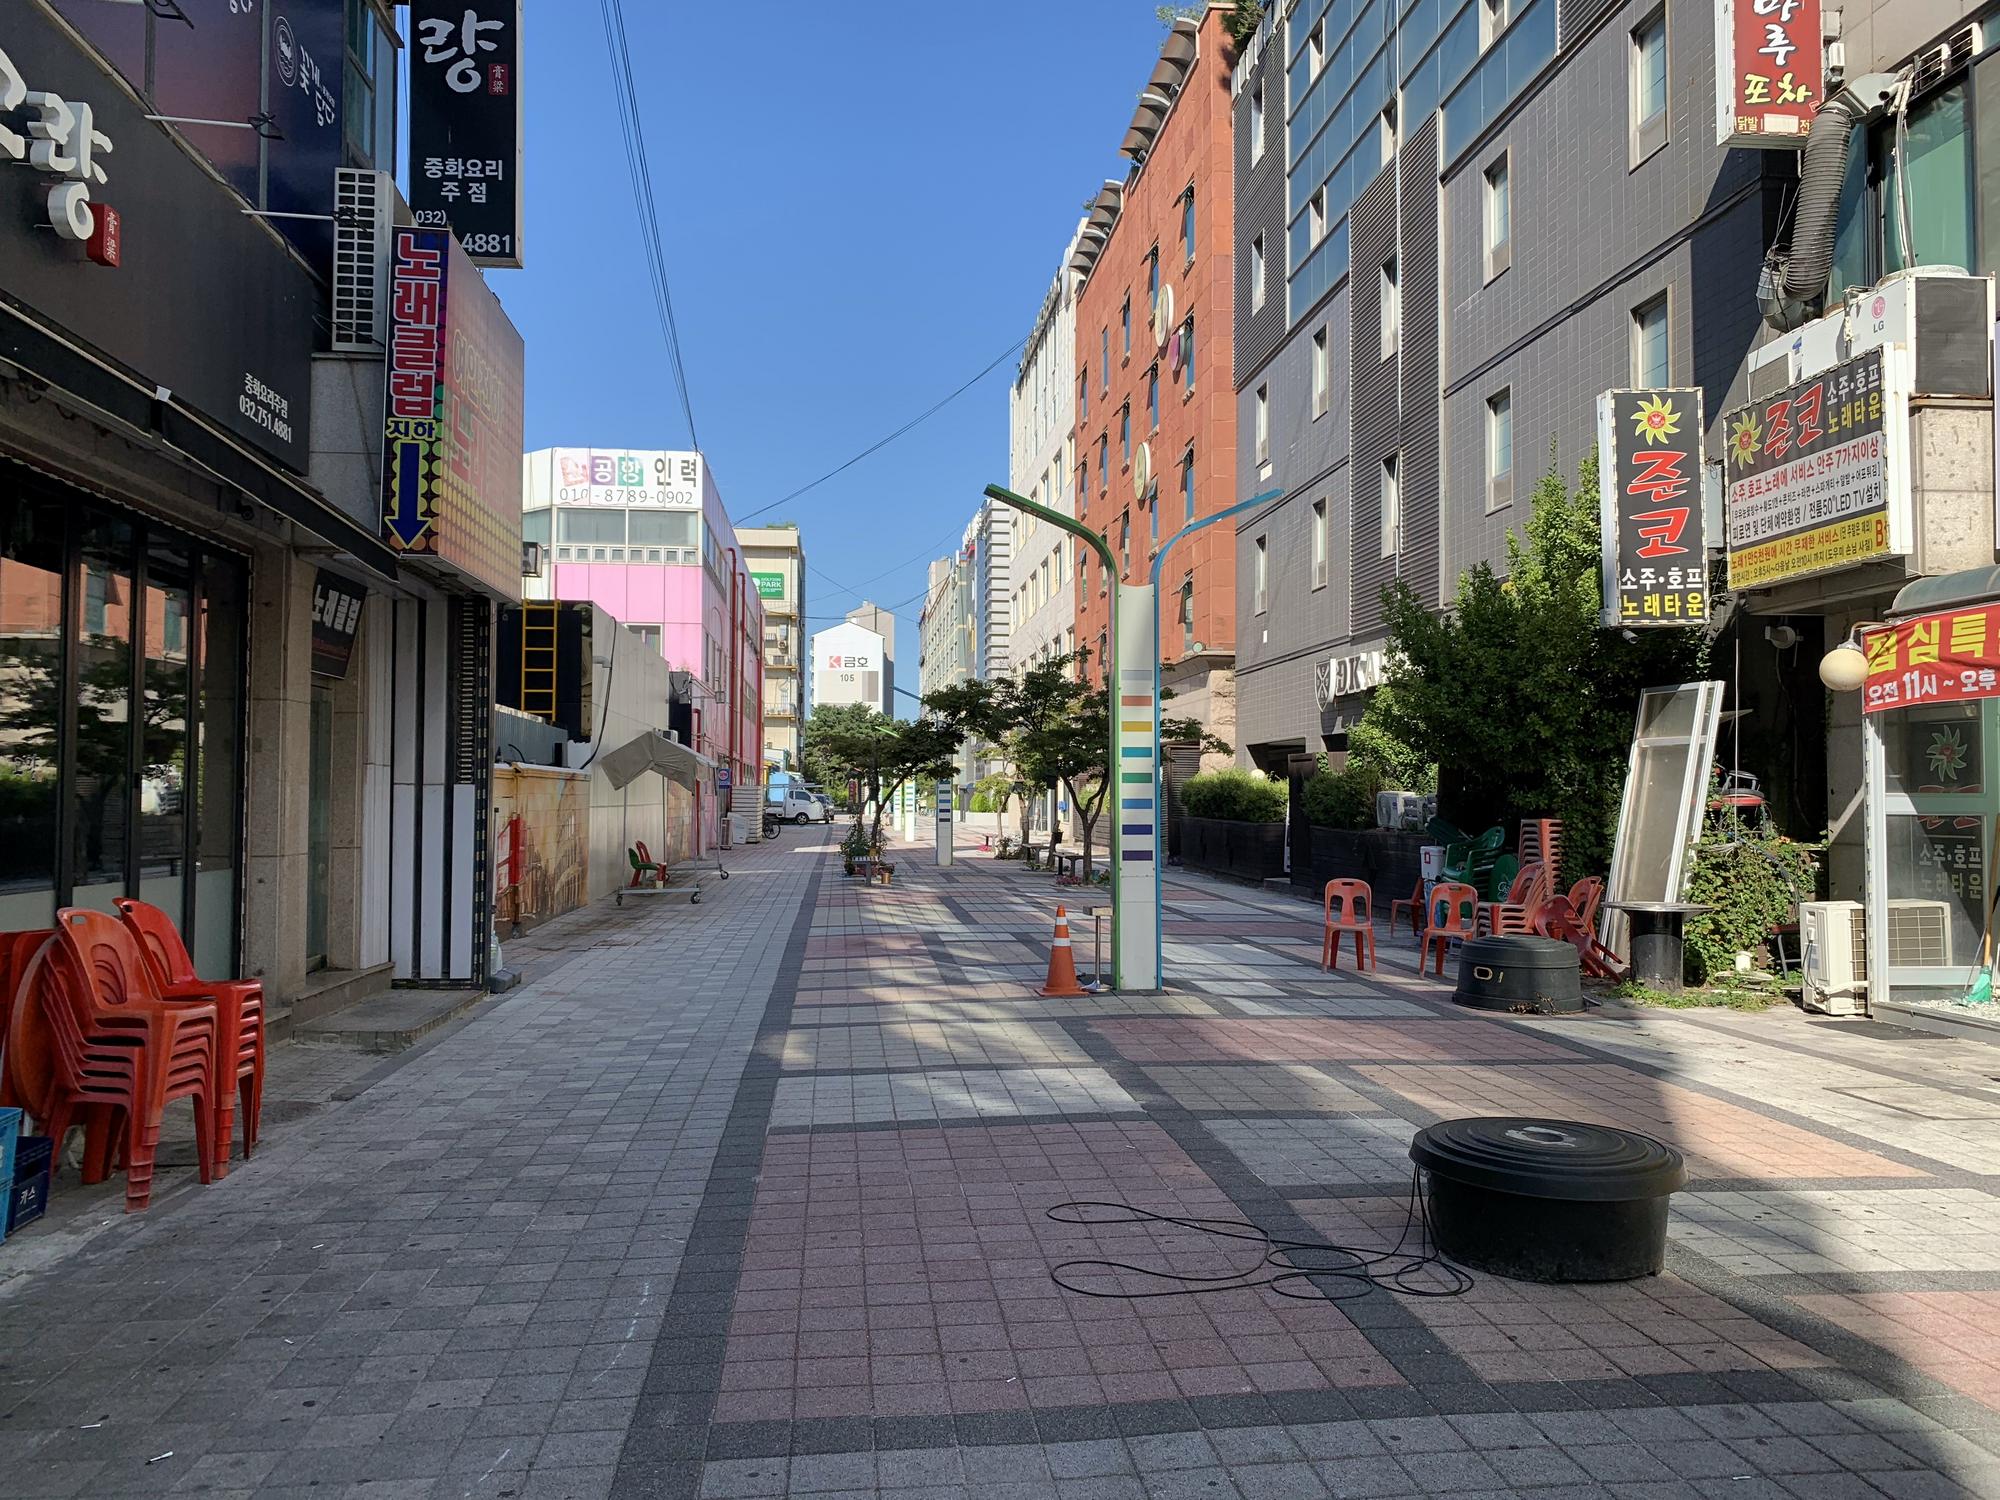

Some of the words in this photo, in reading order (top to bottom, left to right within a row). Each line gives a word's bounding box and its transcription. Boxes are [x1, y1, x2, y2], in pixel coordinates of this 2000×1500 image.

[1744, 72, 1813, 105] 포차
[1737, 115, 1758, 131] 닭발
[423, 157, 503, 180] 중화요리
[415, 210, 447, 225] 032)
[460, 233, 511, 254] 4881
[391, 233, 441, 418] 노래클럽
[1872, 320, 1885, 334] LG
[244, 372, 289, 419] 중화요리주점
[239, 394, 292, 444] 032.751.4881
[1763, 382, 1824, 460] 준코
[1827, 392, 1881, 434] 노래타운
[385, 419, 437, 440] 지하
[1791, 459, 1815, 484] 서비스
[559, 488, 693, 505] 010-8789-0902
[1626, 450, 1692, 560] 준코
[1732, 522, 1751, 542] 피로연
[1752, 520, 1759, 537] 및
[1779, 540, 1793, 557] 시간
[1794, 533, 1815, 553] 무제한
[1818, 528, 1840, 546] 서비스
[1621, 592, 1704, 617] 노래타운
[844, 656, 869, 668] 금호
[840, 674, 855, 682] 105
[1868, 681, 1899, 706] 오전
[1902, 670, 1938, 700] 11시
[1960, 667, 1997, 692] 오후
